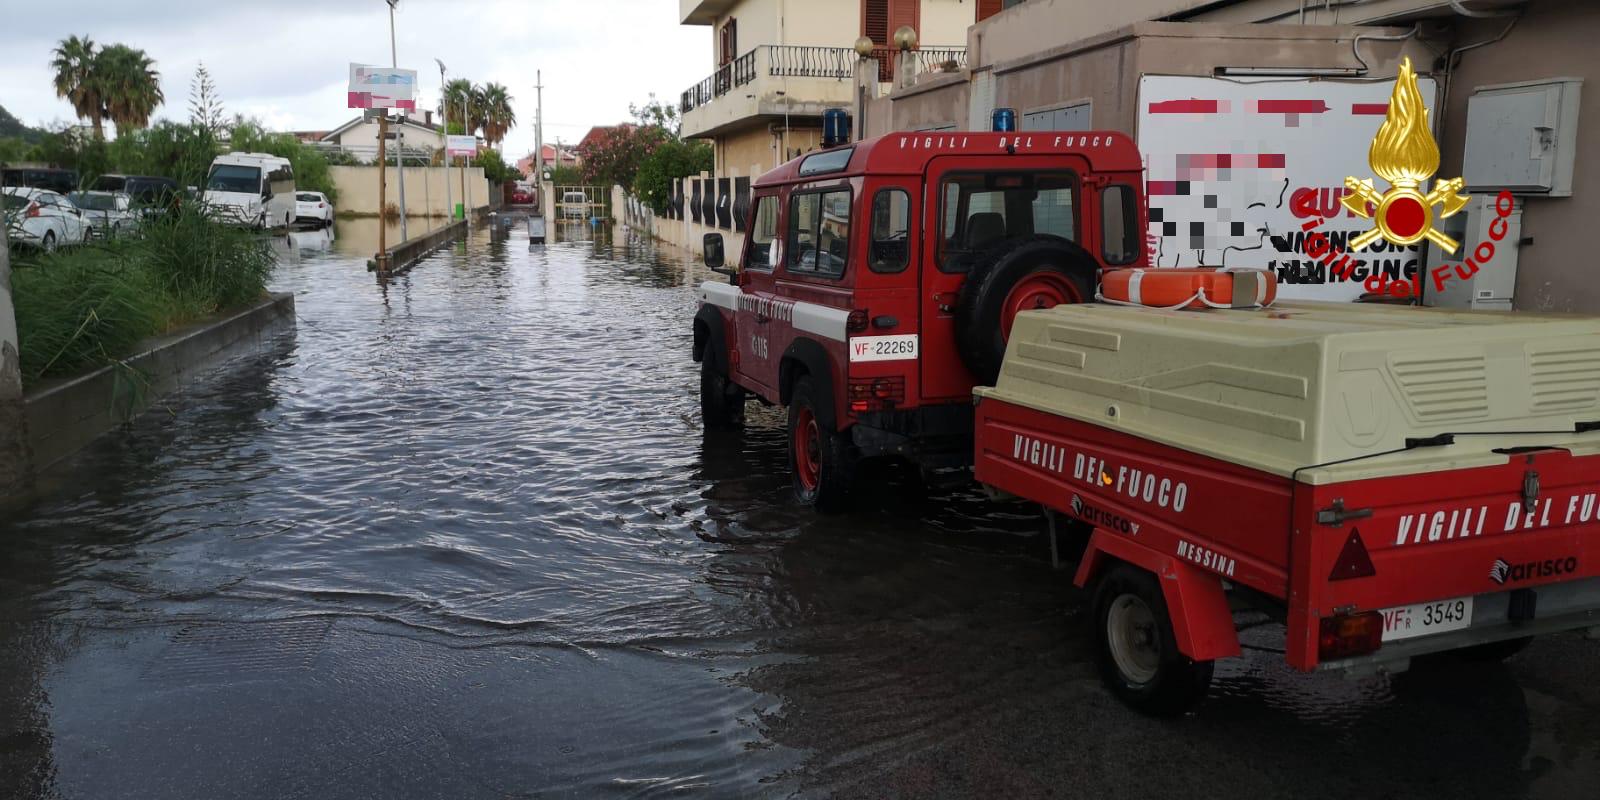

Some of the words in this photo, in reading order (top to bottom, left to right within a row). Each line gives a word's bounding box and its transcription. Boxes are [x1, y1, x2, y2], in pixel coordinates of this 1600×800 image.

[899, 137, 968, 149] VIGILI
[999, 136, 1033, 149] DEL
[1054, 135, 1113, 147] FUOCO
[854, 342, 870, 356] VF
[876, 340, 914, 355] 22269
[1013, 434, 1066, 473] VIGILI
[1073, 453, 1105, 488] DEL
[1116, 466, 1189, 513] FUOCO
[1396, 506, 1488, 545] VIGILI
[1504, 497, 1553, 531] DEL
[1565, 493, 1600, 524] FU
[1177, 539, 1236, 577] MESSINA
[1384, 608, 1406, 632] VF
[1423, 600, 1465, 626] 3549
